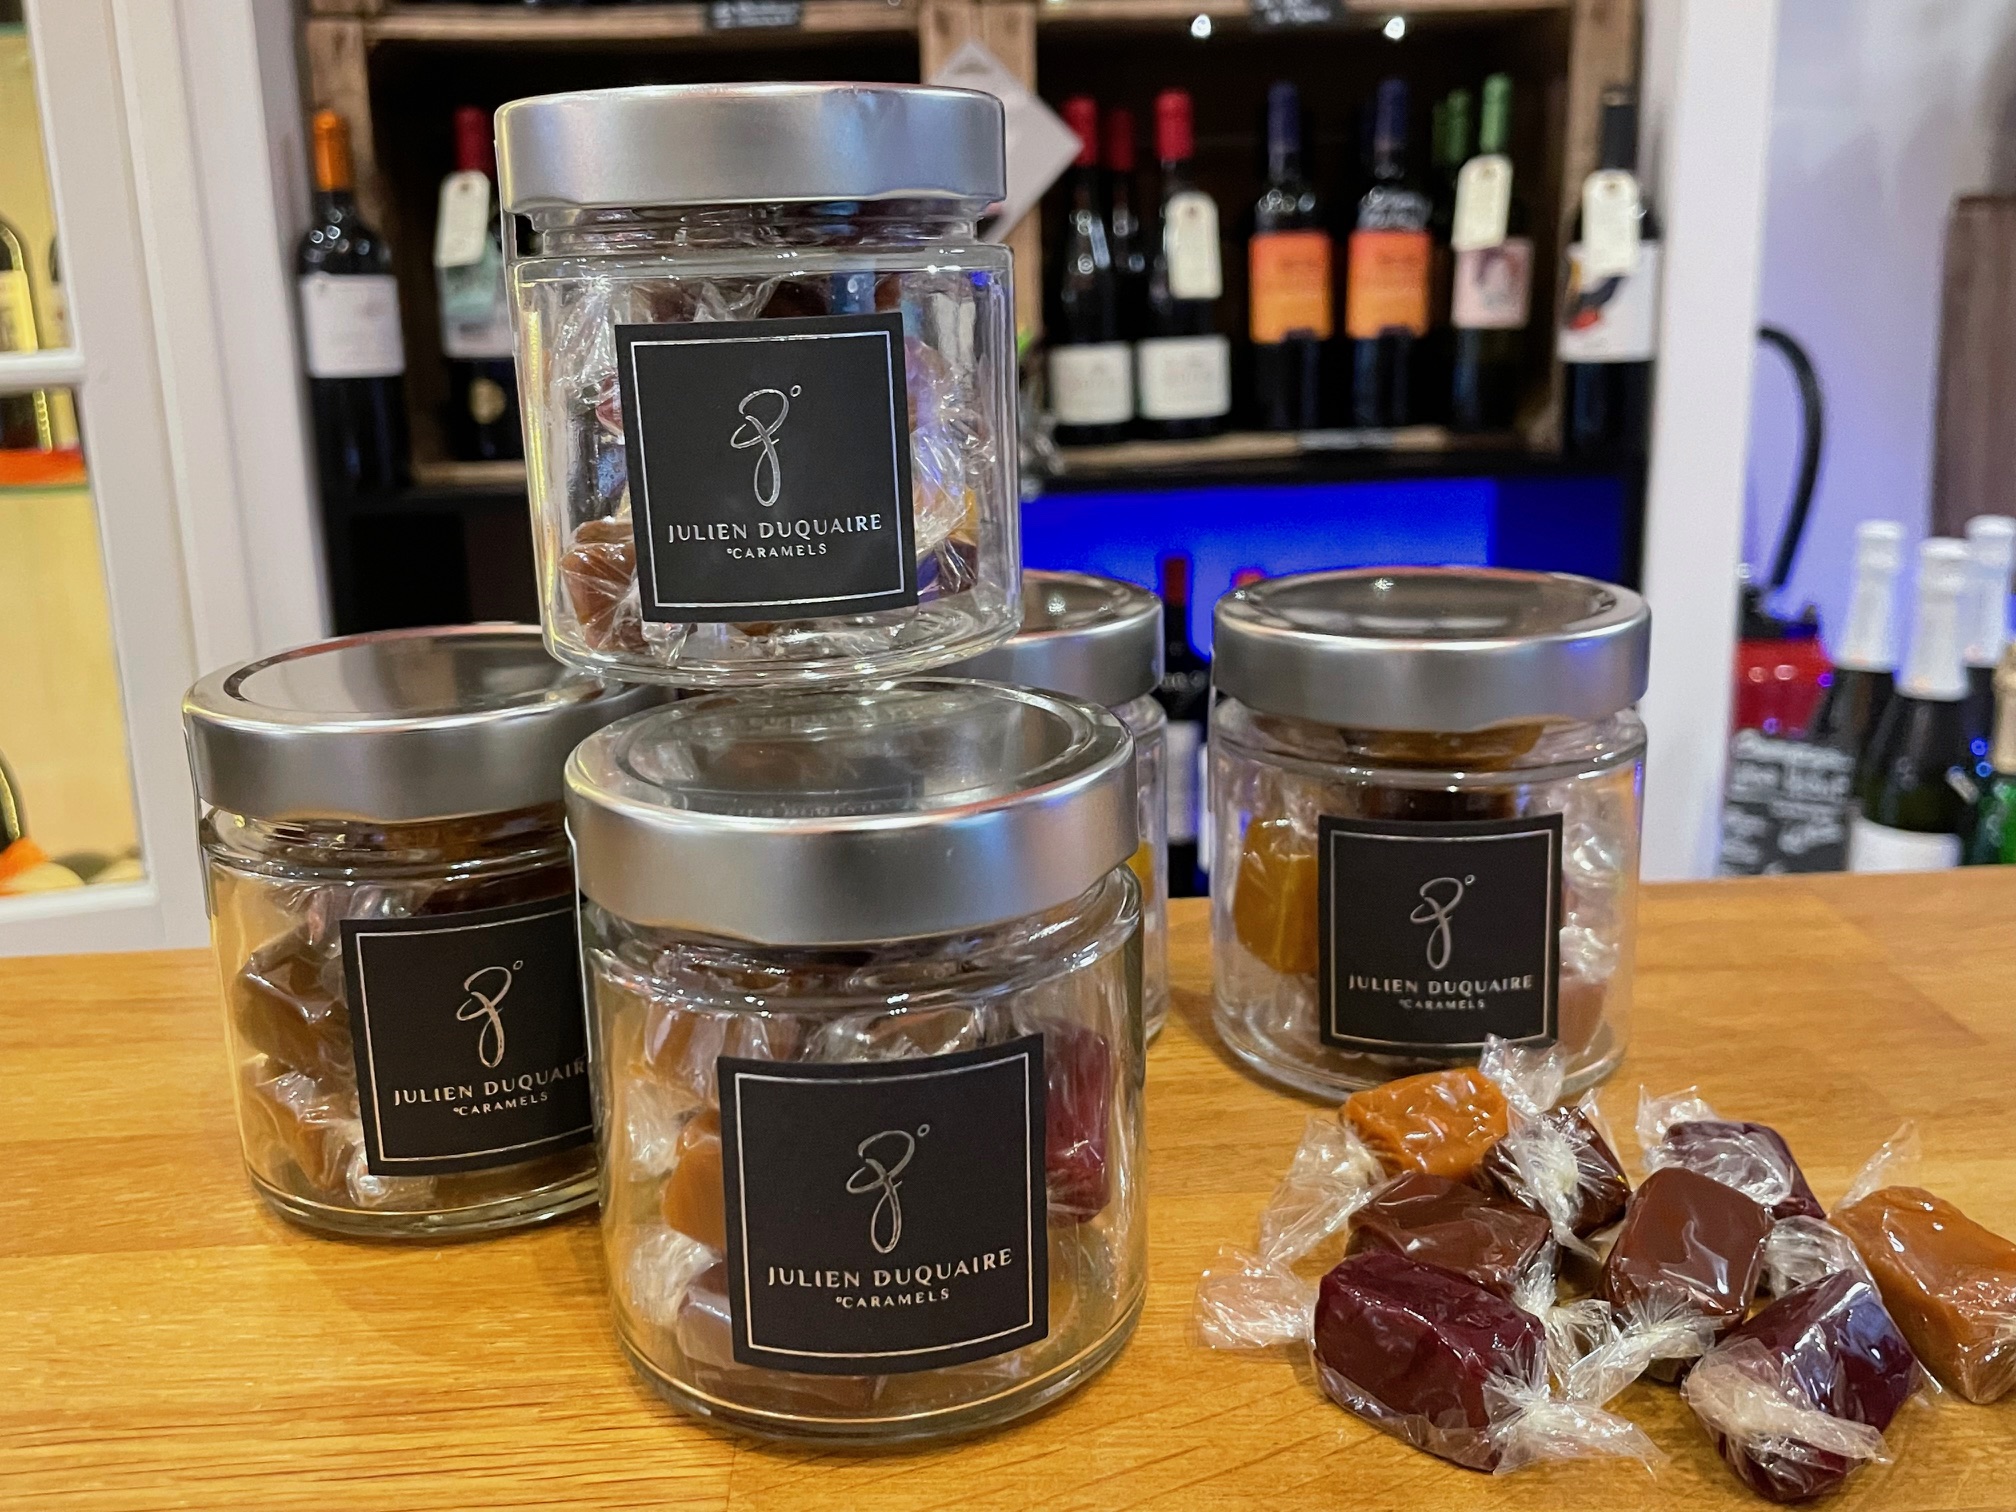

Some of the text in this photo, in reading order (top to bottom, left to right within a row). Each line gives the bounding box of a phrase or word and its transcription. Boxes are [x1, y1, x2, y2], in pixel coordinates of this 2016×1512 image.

[668, 513, 883, 544] JULIEN DUQUAIRE
[1349, 974, 1534, 997] JULIEN DUQUAIRE
[394, 1058, 586, 1106] JULIEN DUQUAIR
[768, 1248, 1013, 1289] JULIEN DUQUAIRE
